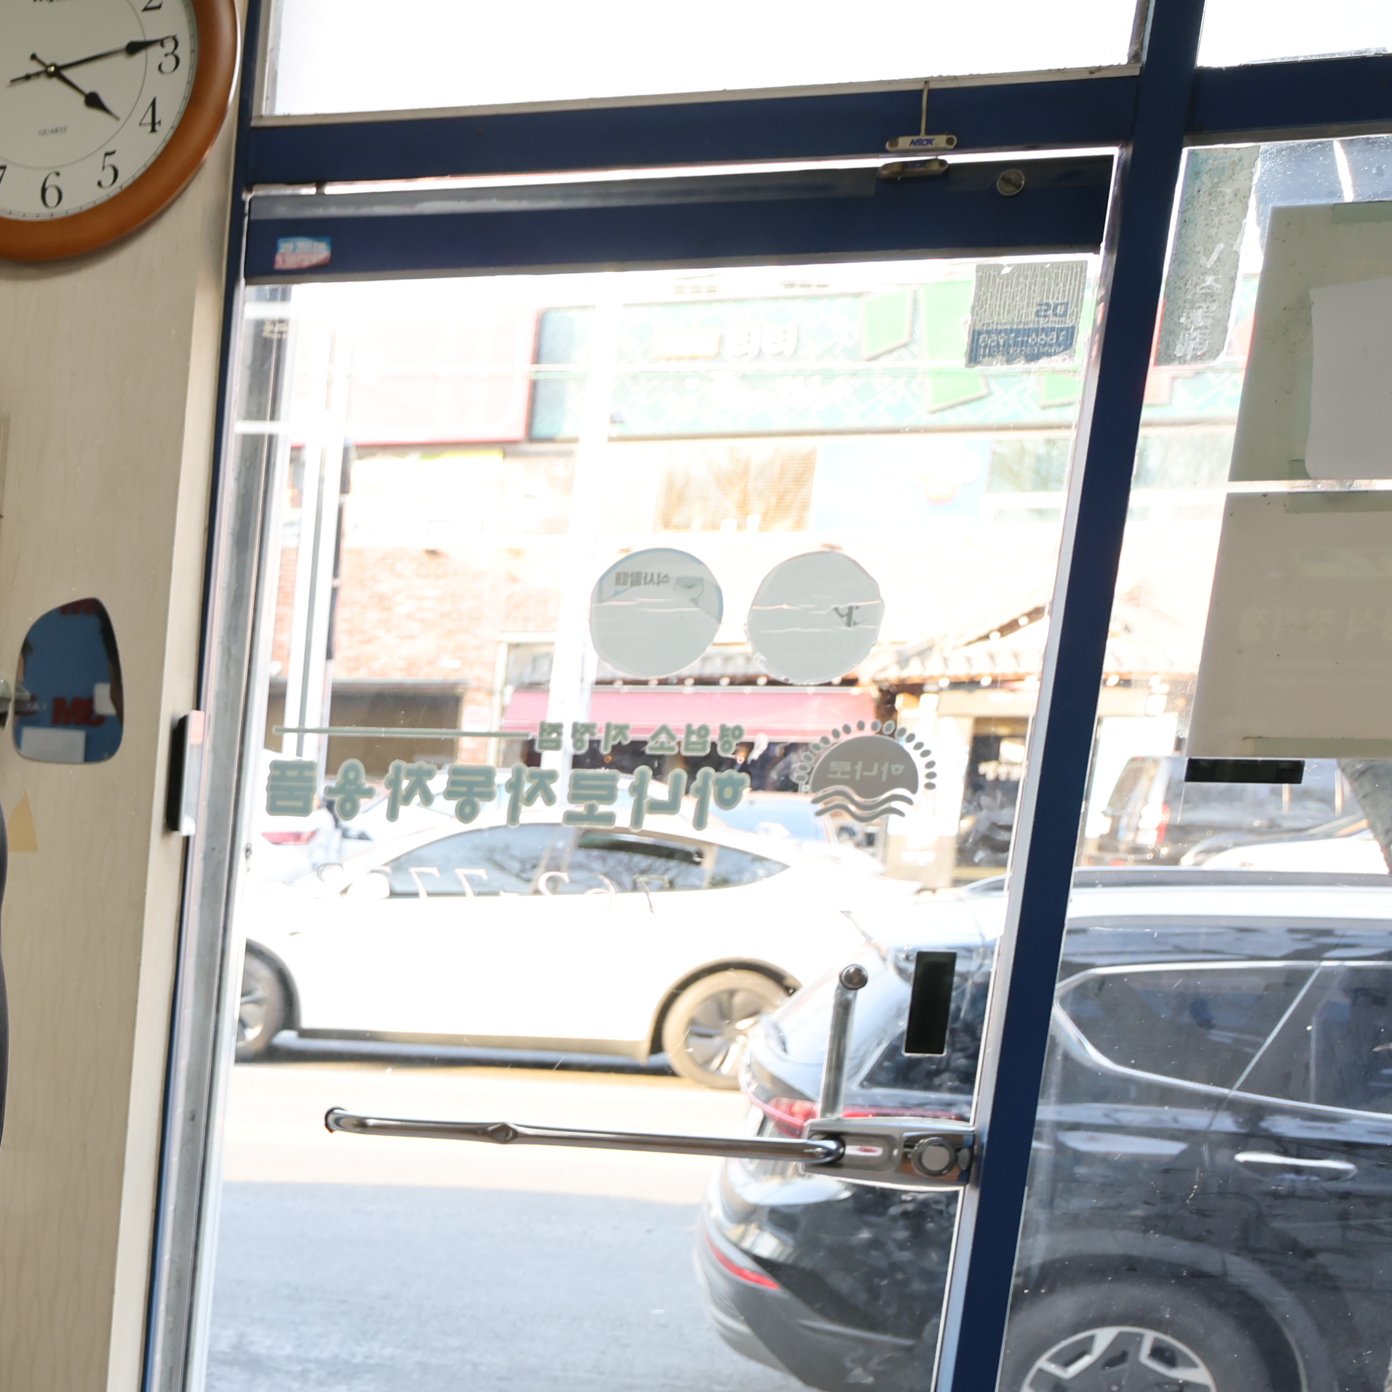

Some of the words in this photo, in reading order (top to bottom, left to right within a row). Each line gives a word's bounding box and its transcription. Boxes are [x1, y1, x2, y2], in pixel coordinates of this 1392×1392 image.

[157, 33, 181, 75] 3
[138, 96, 161, 134] 4
[96, 150, 119, 189] 5
[40, 171, 64, 209] 6
